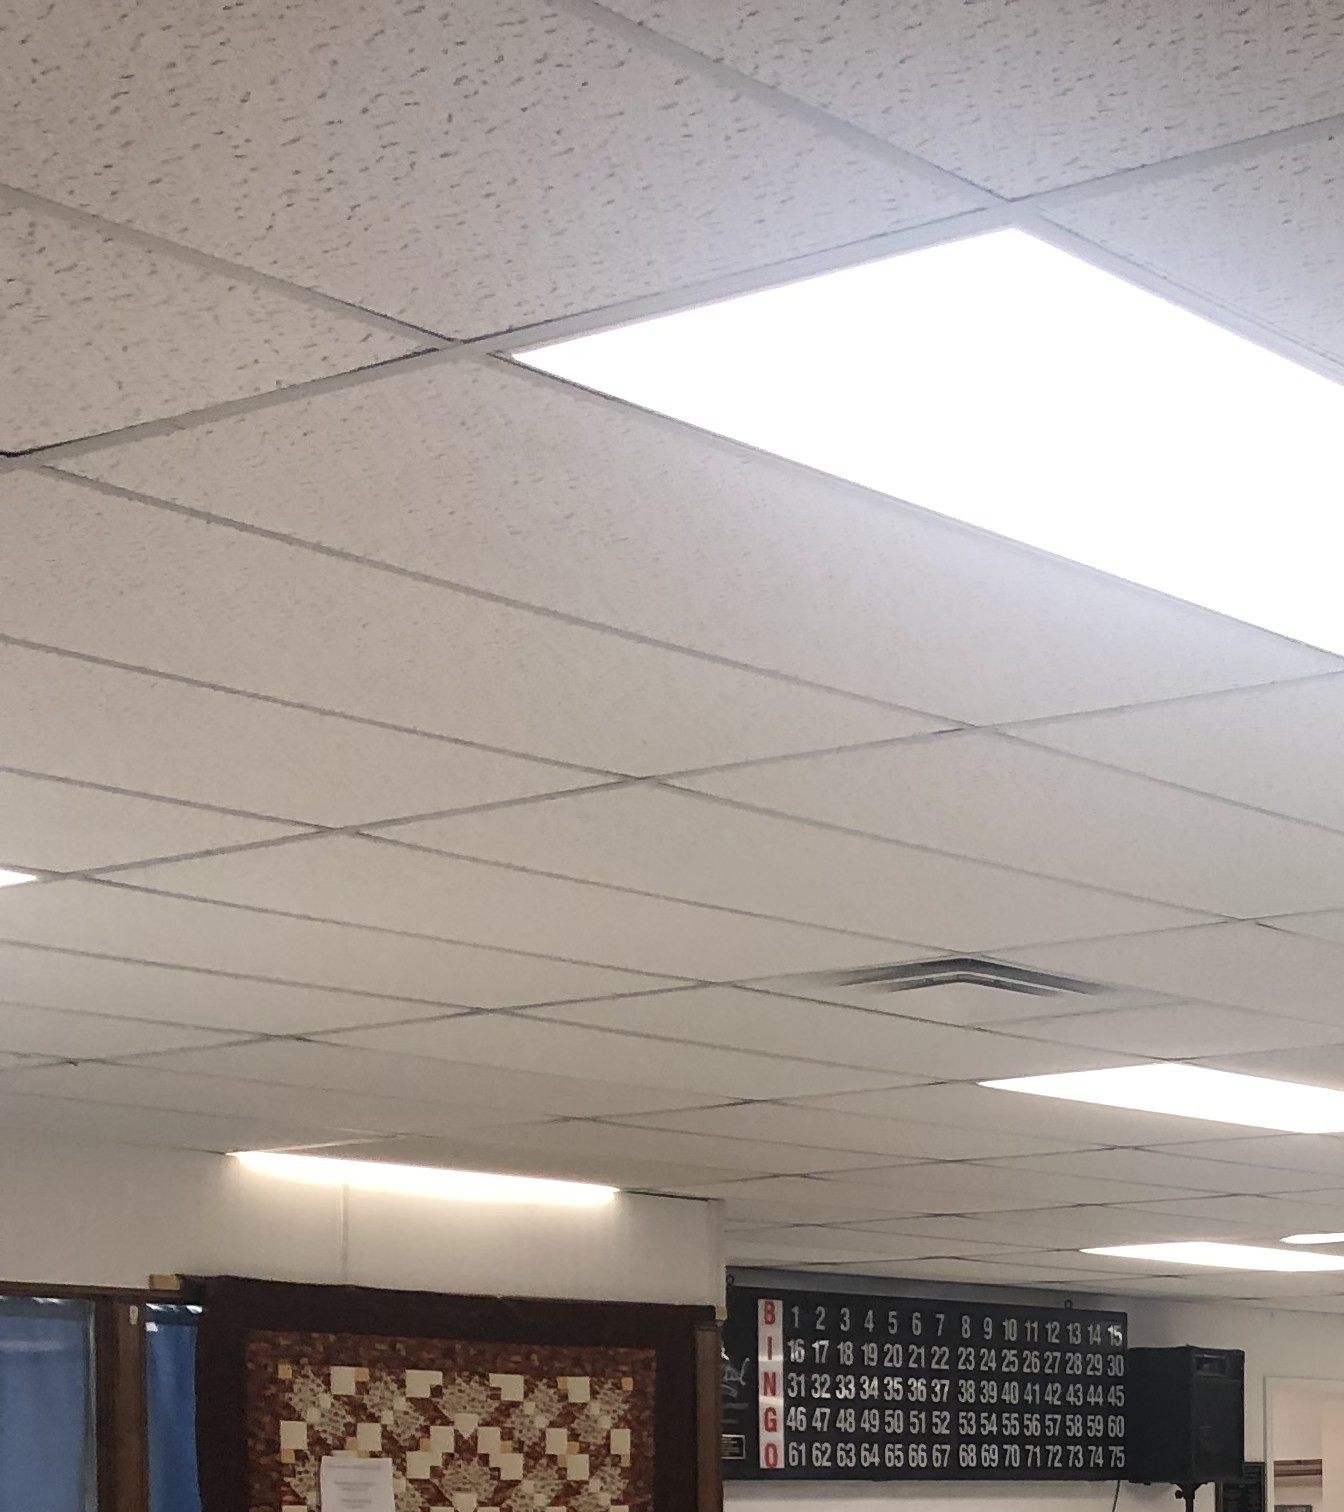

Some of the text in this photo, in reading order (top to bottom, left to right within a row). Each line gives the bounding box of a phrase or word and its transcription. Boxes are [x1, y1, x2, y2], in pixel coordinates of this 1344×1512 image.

[792, 1306, 1122, 1346] 1 2 3 4 5 6 7 8 9 10 11 12 13 14 15
[788, 1339, 1124, 1376] 16 17 18 19 20 21 22 23 24 25 26 27 28 29 30
[788, 1373, 1124, 1406] 31 32 33 34 35 36 37 38 39 40 41 42 43 44 45
[786, 1407, 1124, 1437] 46 47 48 49 50 51 52 53 54 55 56 57 58 59 60
[789, 1442, 1125, 1467] 61 62 63 64 65 66 67 68 69 70 71 72 73 74 75
